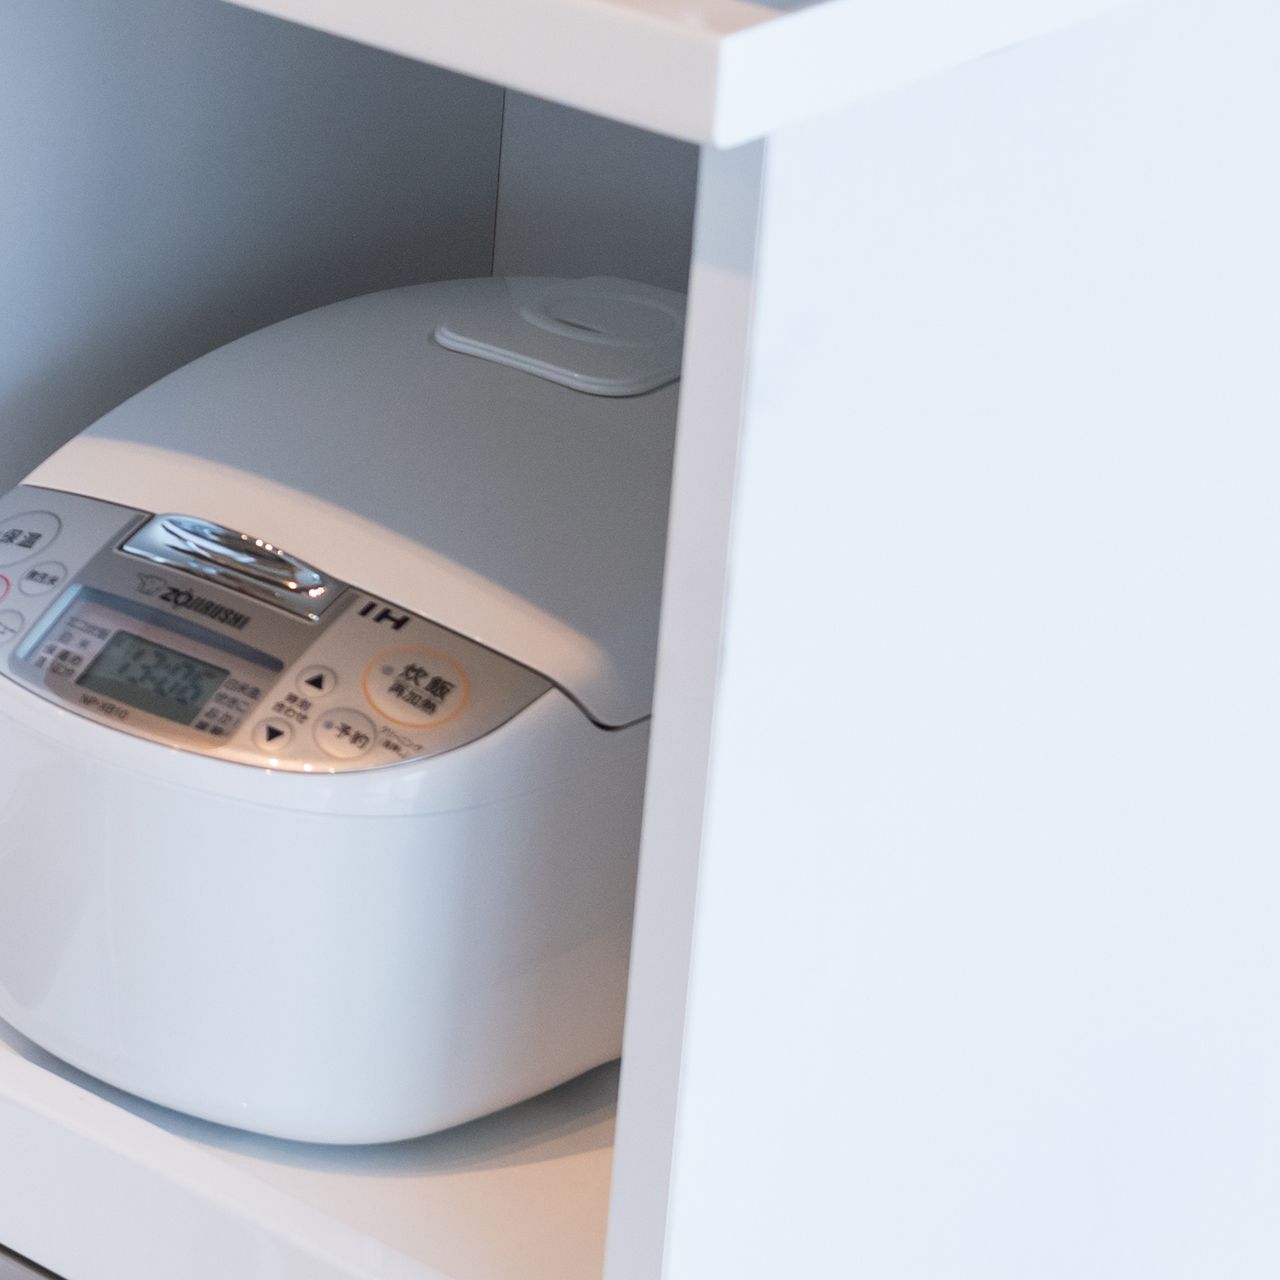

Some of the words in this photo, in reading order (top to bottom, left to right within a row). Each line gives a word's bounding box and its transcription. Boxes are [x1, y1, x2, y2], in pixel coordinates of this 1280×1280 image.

[159, 587, 251, 631] ZOJIRUSHI
[358, 601, 410, 631] IH
[398, 662, 456, 702] 炊飯
[334, 721, 370, 750] 予約
